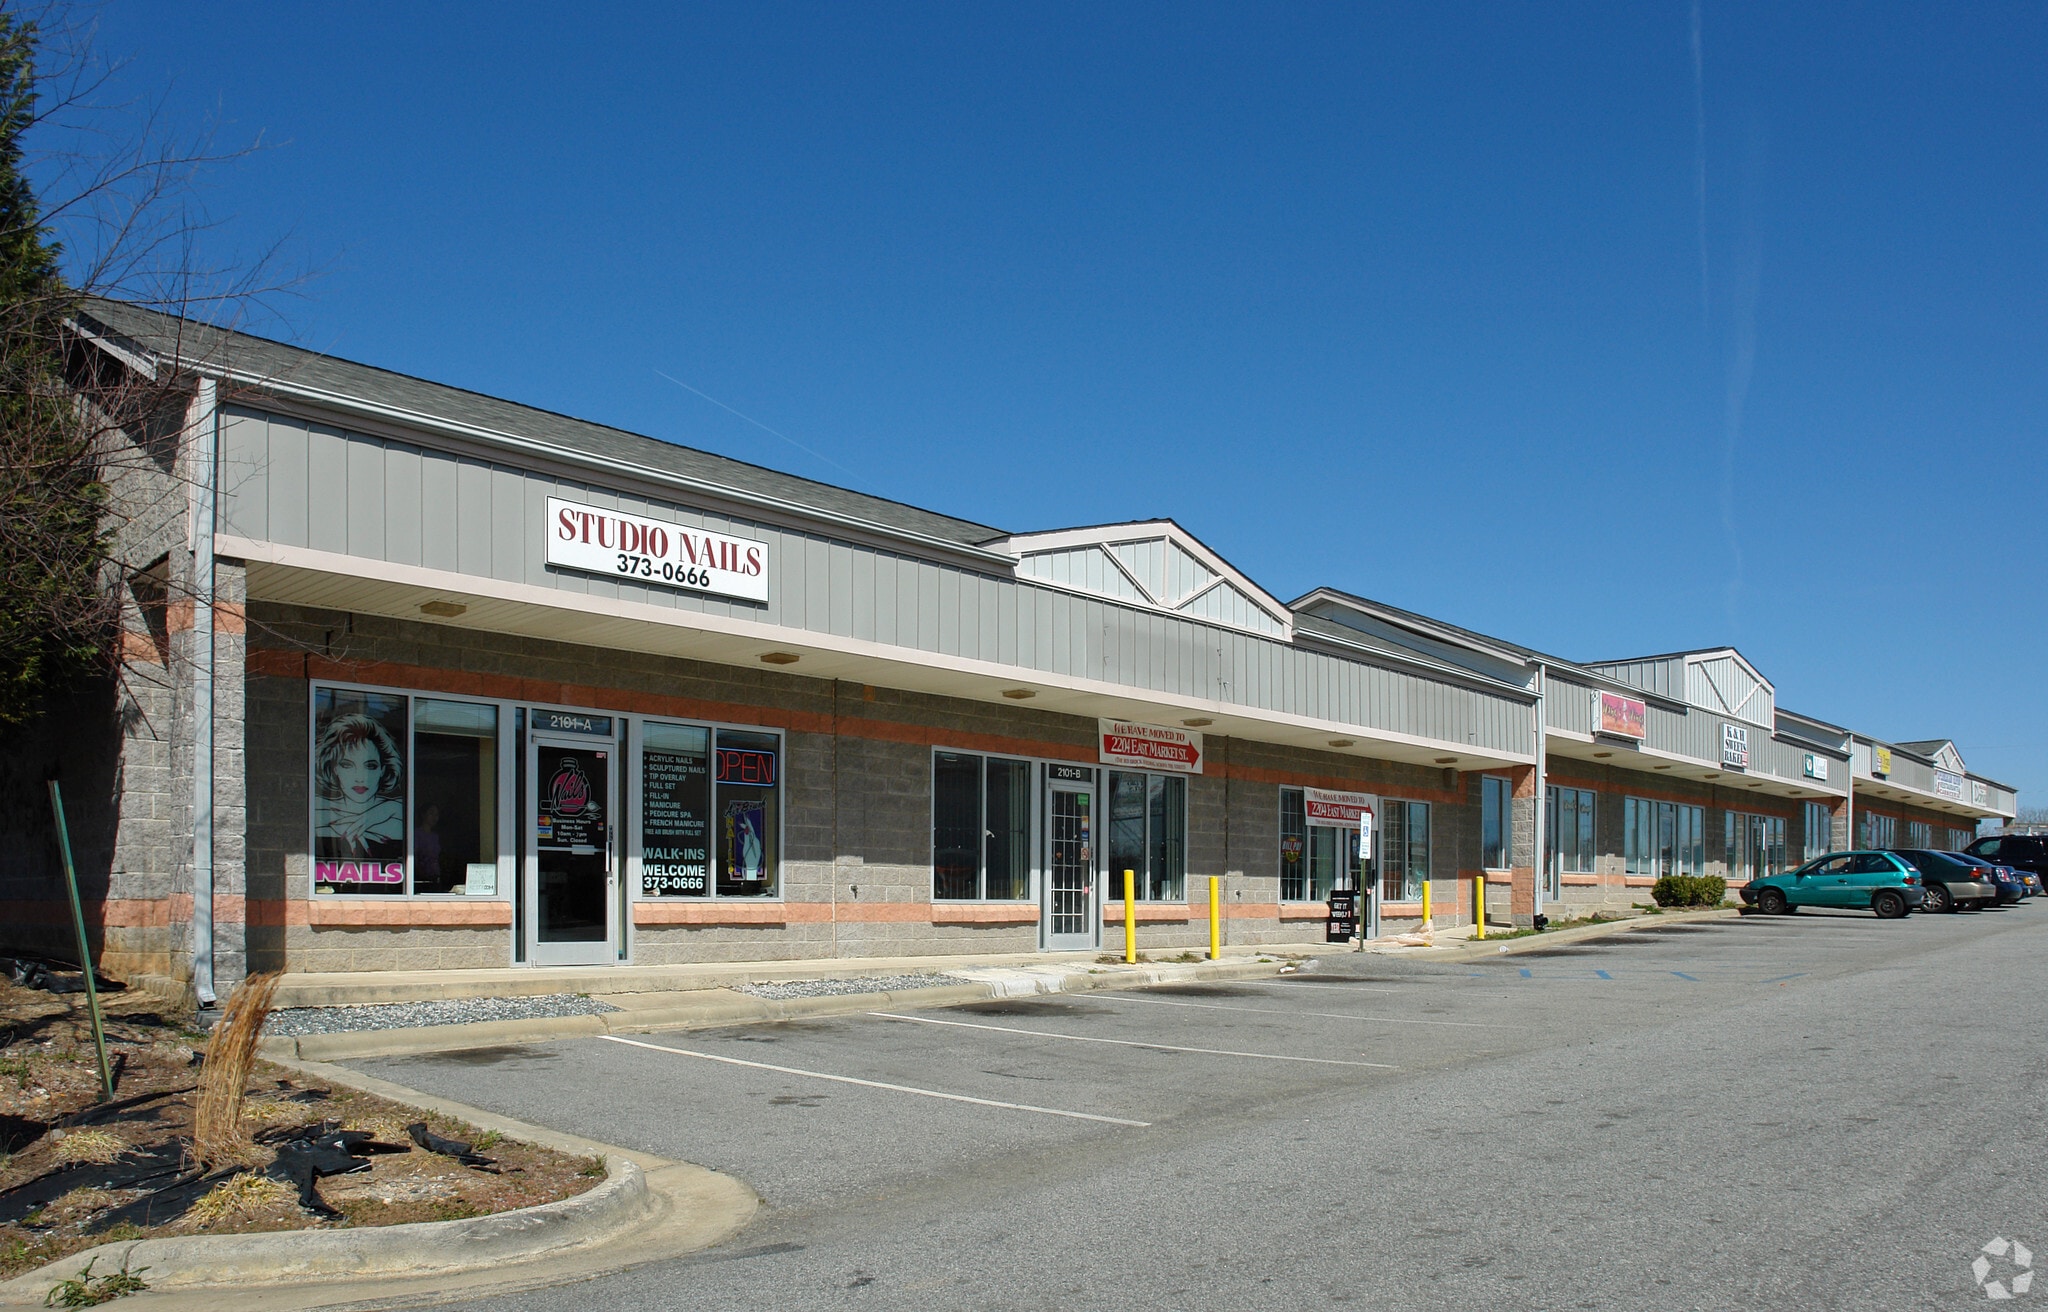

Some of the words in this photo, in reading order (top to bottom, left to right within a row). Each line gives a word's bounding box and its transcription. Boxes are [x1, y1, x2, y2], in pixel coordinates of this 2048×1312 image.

[559, 508, 668, 558] STUDIO
[679, 532, 761, 577] NAILS
[617, 554, 710, 587] 373-0666
[550, 715, 592, 731] 2101-A
[1127, 726, 1148, 736] HAVE
[1149, 729, 1174, 740] MOVED
[1176, 732, 1185, 742] TO
[1726, 726, 1732, 738] K
[1111, 736, 1130, 754] 2204
[648, 755, 674, 763] ACRYLIC
[648, 764, 688, 773] SCULPTURED
[1058, 768, 1081, 778] 2101-B
[1312, 802, 1326, 816] 2204
[642, 848, 706, 860] WALK-INS
[316, 861, 404, 884] NAILS
[642, 864, 706, 876] WELCOME
[644, 877, 704, 889] 373-0666
